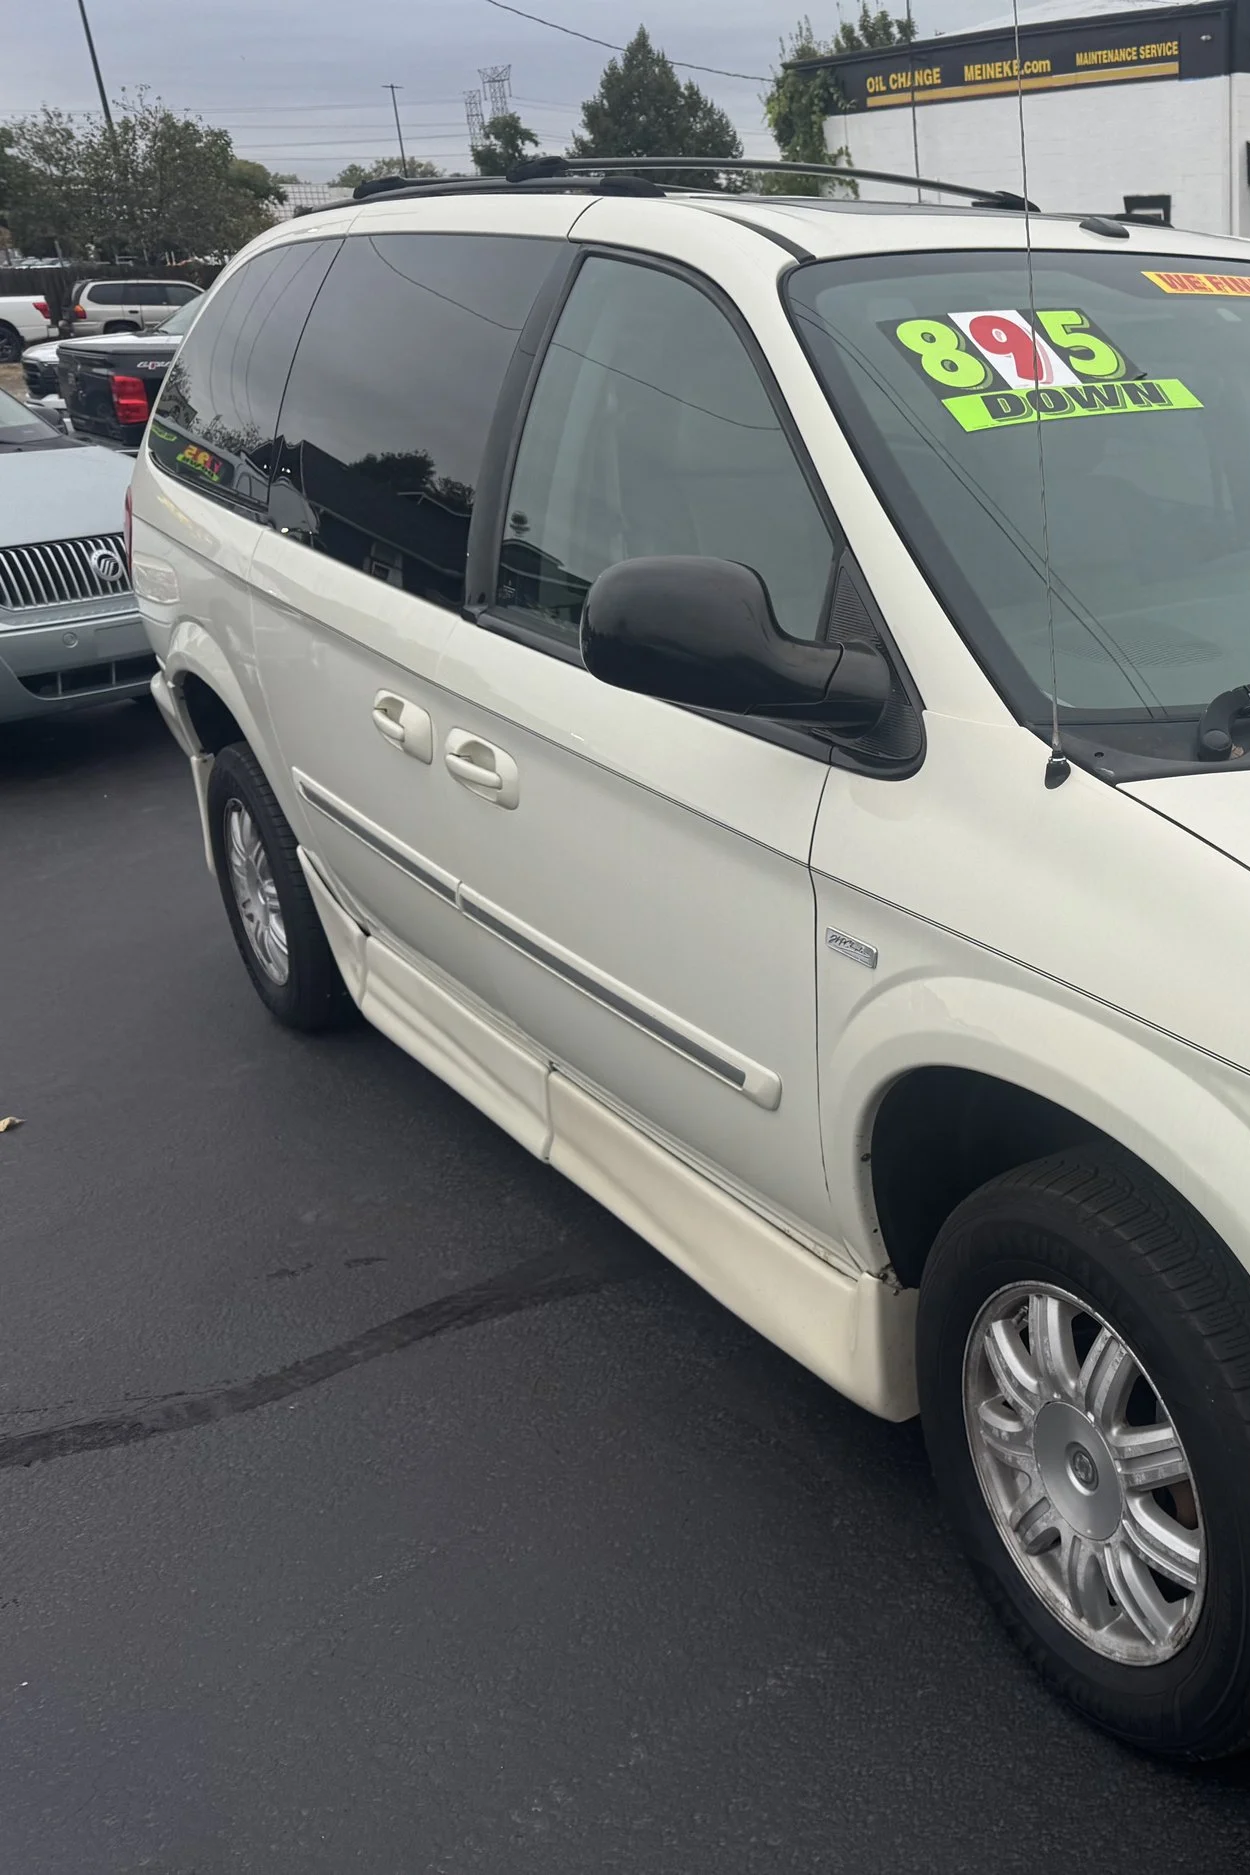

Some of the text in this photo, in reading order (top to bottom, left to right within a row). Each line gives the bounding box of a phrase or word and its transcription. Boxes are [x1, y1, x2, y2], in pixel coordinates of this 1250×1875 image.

[1076, 41, 1178, 66] MAINTENANCE SERVICE
[964, 59, 1051, 82] MEINEKE.com
[866, 76, 887, 93] OIL
[1155, 273, 1213, 293] WE
[896, 310, 1125, 389] 895
[980, 381, 1173, 421] DOWN
